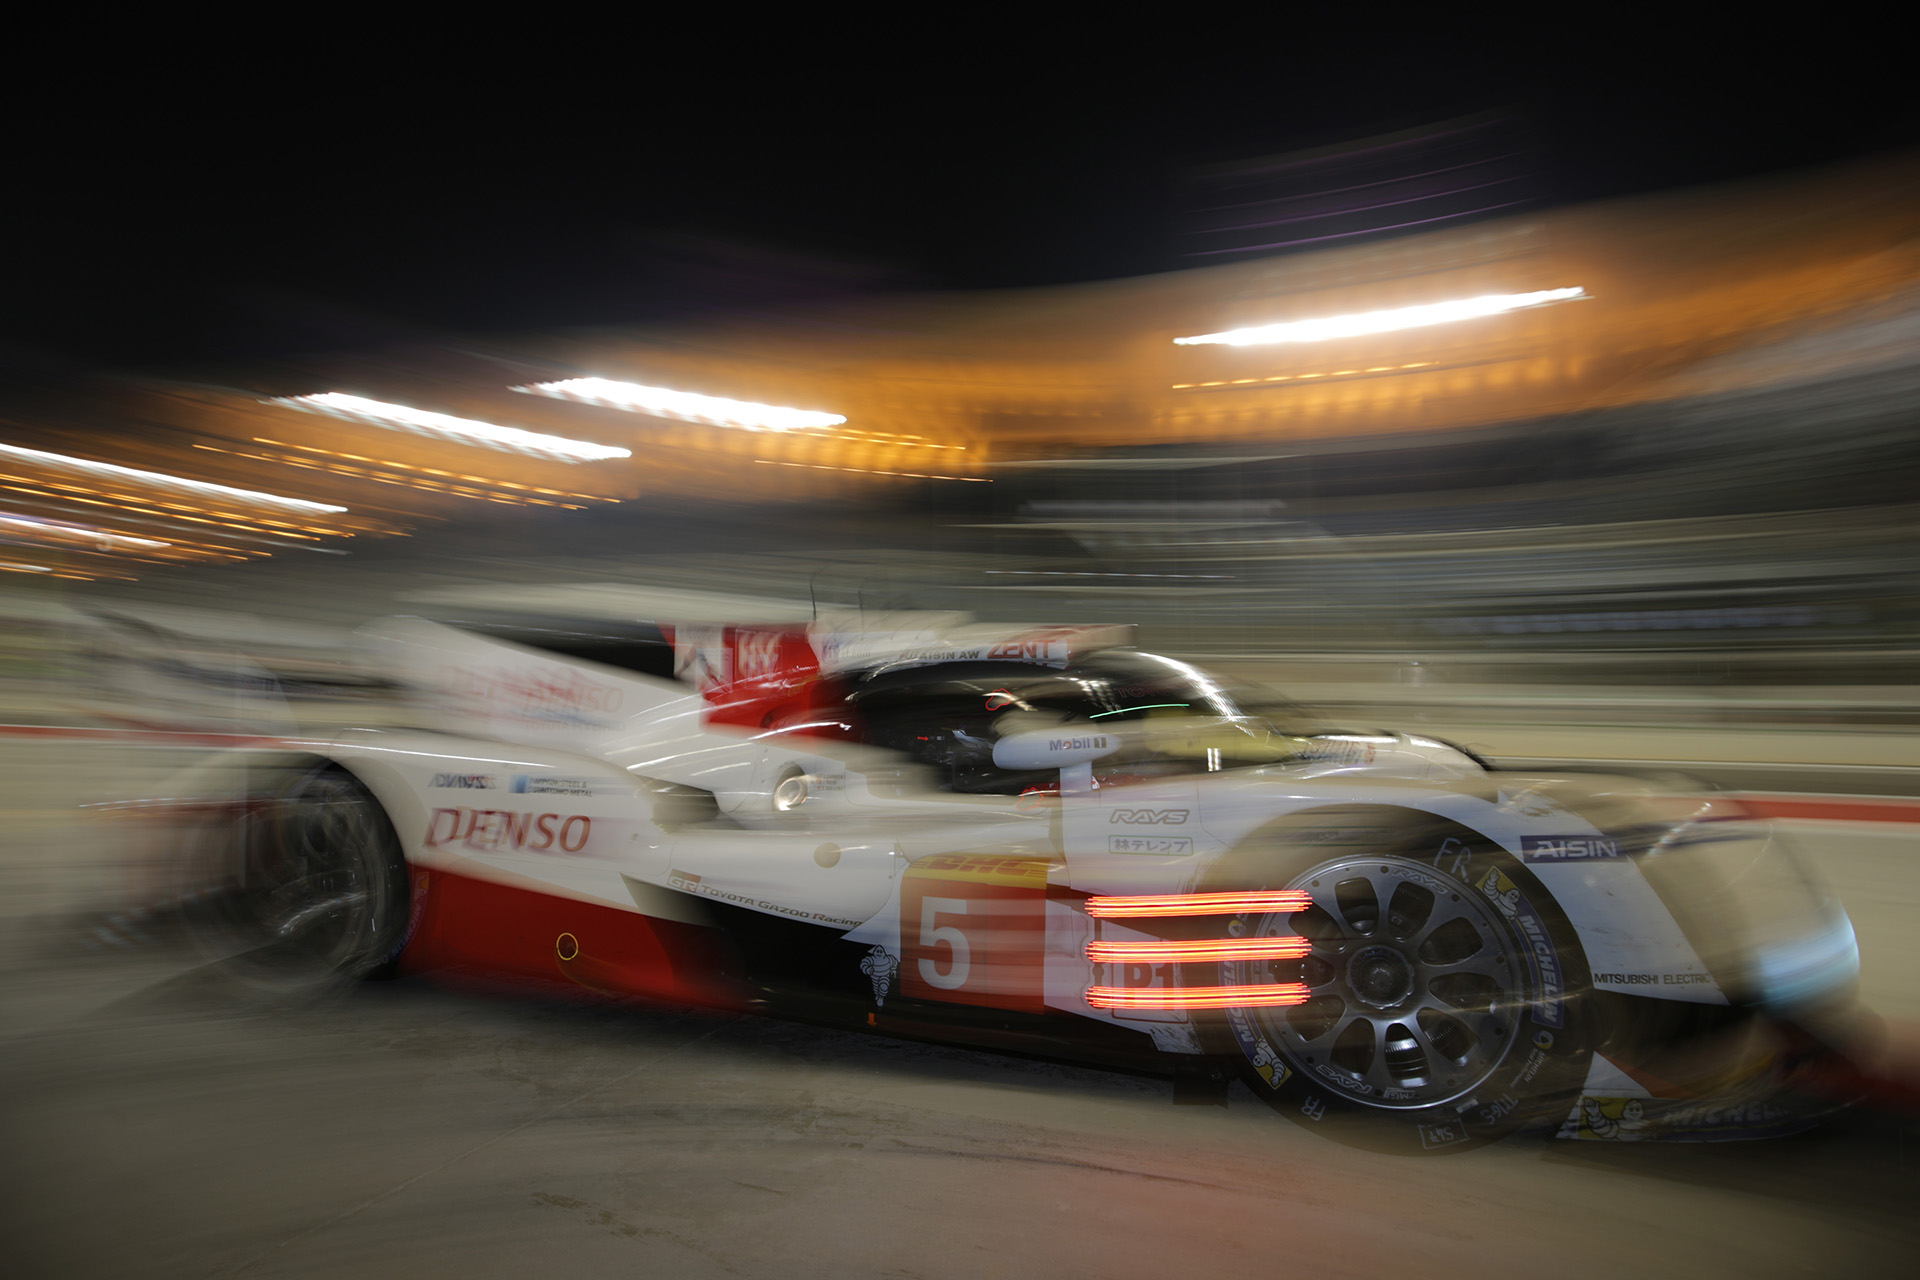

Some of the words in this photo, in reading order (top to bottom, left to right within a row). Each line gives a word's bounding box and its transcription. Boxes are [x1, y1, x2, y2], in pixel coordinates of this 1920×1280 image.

[919, 651, 955, 661] AISIN
[958, 650, 980, 660] AW
[987, 640, 1056, 659] ZENT
[1050, 737, 1090, 751] Mobil
[570, 789, 592, 798] METAL
[1109, 809, 1189, 825] RAYS
[424, 806, 591, 852] DENSO
[1114, 838, 1188, 853] 林テレンプ
[1532, 840, 1618, 858] AISIN
[1433, 837, 1472, 883] FR
[1391, 869, 1449, 895] RAYS
[668, 876, 699, 893] GR
[701, 884, 755, 906] TOYOTA
[812, 912, 862, 928] Racing
[917, 895, 971, 990] 5
[1517, 914, 1557, 1023] MICHELIN
[1594, 973, 1659, 985] MITSUBISHI
[1663, 973, 1711, 985] ELECTRIC
[1315, 1063, 1373, 1095] RAYS
[1301, 1095, 1327, 1122] FR
